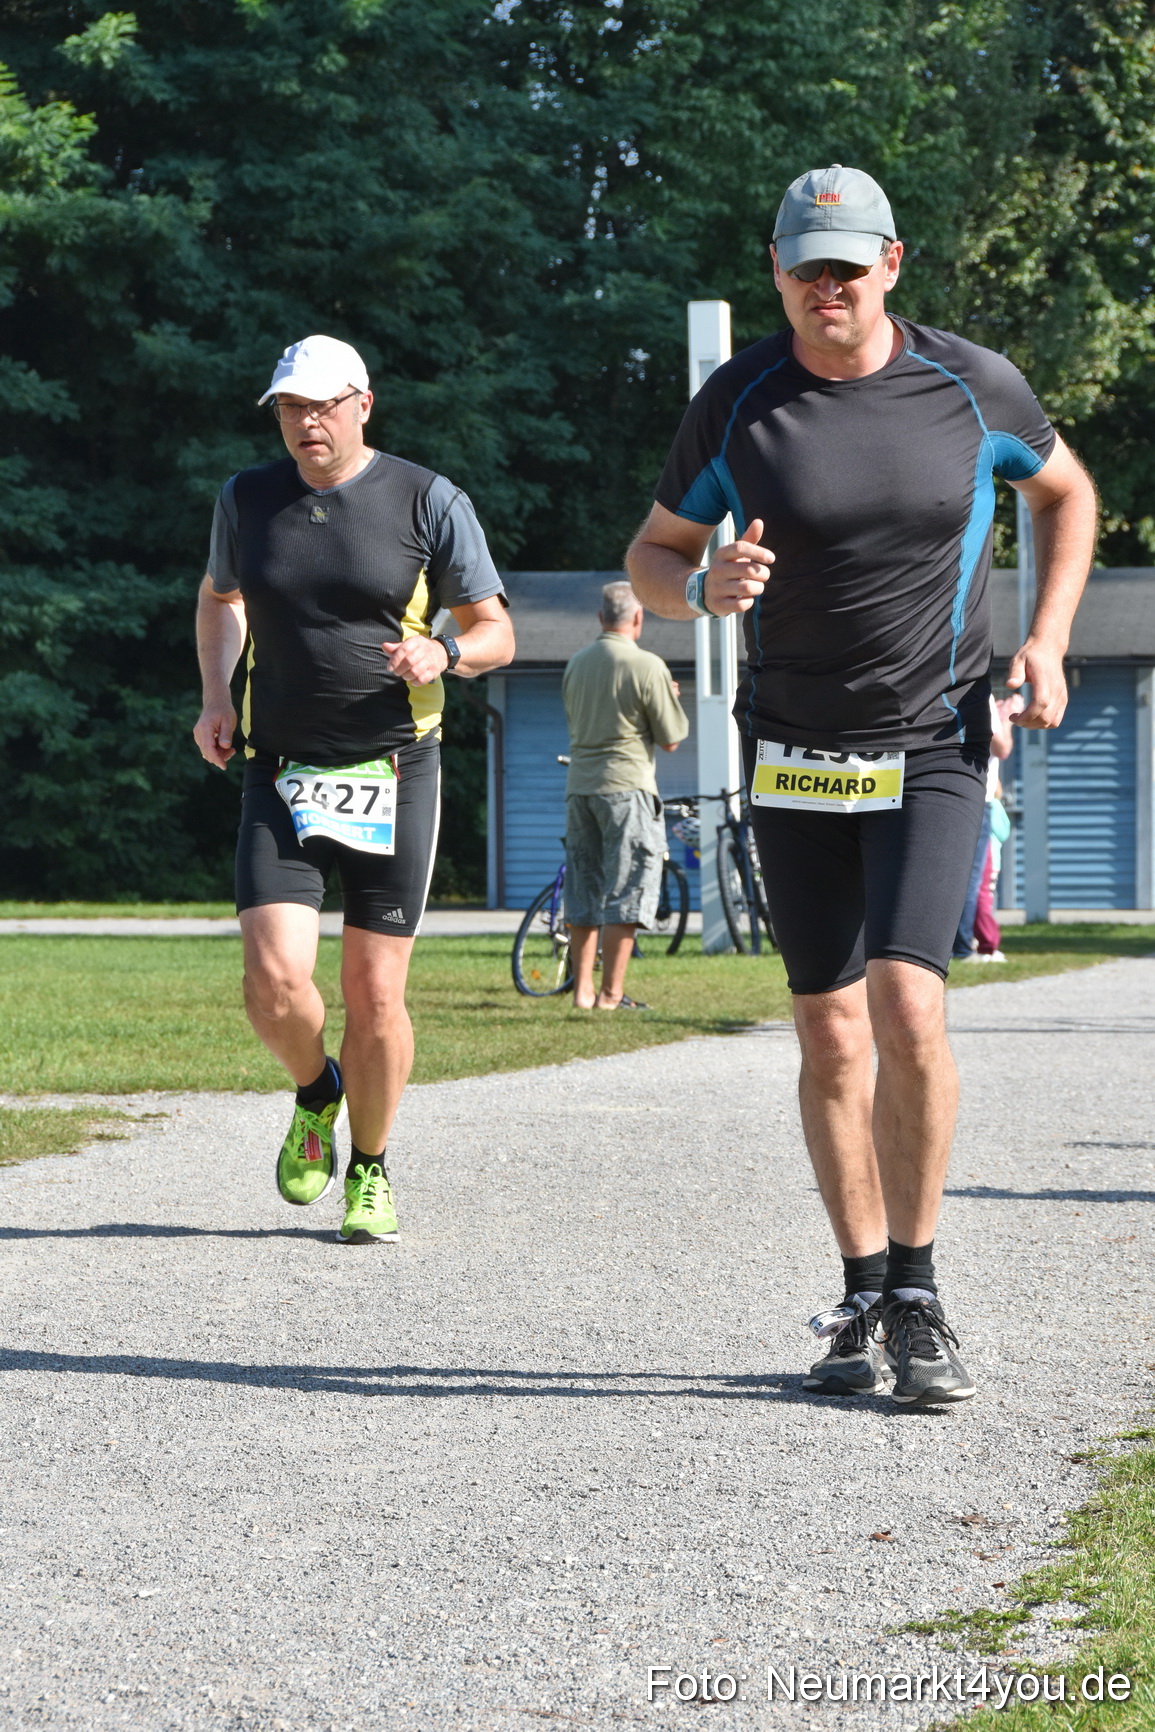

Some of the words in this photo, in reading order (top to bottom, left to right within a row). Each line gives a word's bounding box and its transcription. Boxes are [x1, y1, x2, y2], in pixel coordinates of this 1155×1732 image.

[820, 193, 841, 203] PERI
[775, 773, 877, 796] RICHARD
[286, 778, 380, 816] 2427
[382, 914, 406, 925] adidas
